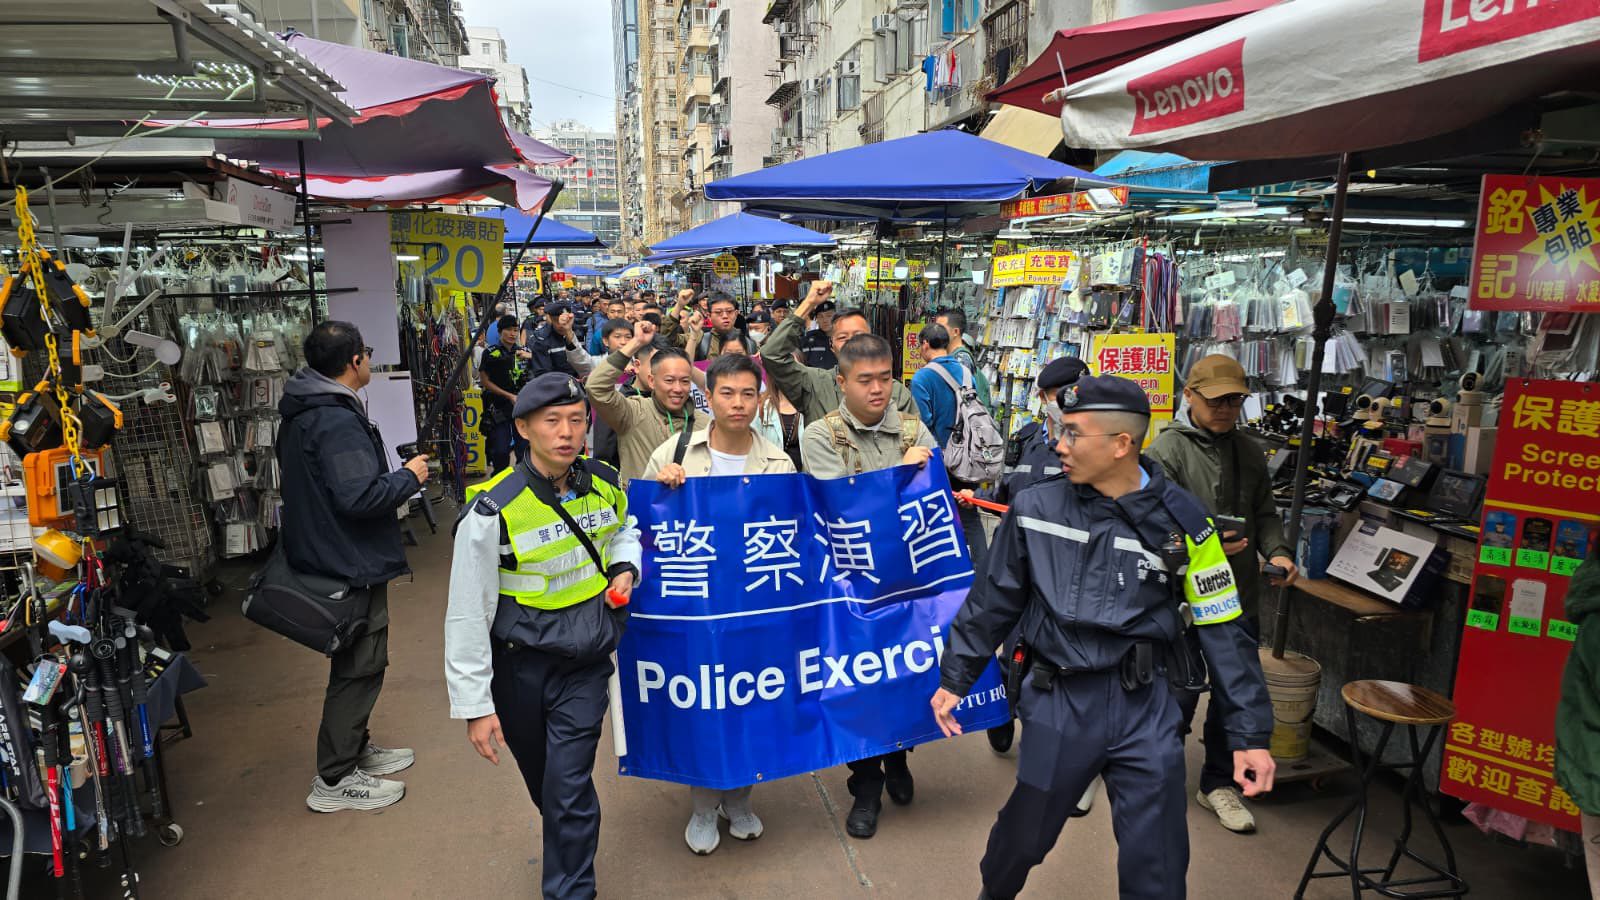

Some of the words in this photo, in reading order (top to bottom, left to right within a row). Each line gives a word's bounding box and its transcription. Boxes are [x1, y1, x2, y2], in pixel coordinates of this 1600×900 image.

[1137, 67, 1233, 119] Lenovo
[1531, 190, 1583, 233] 專業
[1478, 187, 1527, 299] 銘記
[1545, 220, 1593, 264] 包貼
[424, 243, 484, 288] 20
[1028, 274, 1050, 282] Power
[1030, 254, 1070, 268] 充電寶
[1098, 346, 1170, 373] 保護貼
[555, 514, 596, 537] POICE
[651, 489, 962, 599] 警察演習
[1194, 569, 1231, 595] Exercise
[1204, 597, 1237, 616] POLICE
[637, 660, 786, 711] Police
[799, 625, 945, 694] Exerci
[956, 692, 986, 711] PTU
[989, 684, 1007, 703] HQ
[342, 788, 370, 799] HOKA
[1447, 756, 1581, 817] 歡迎查詢
